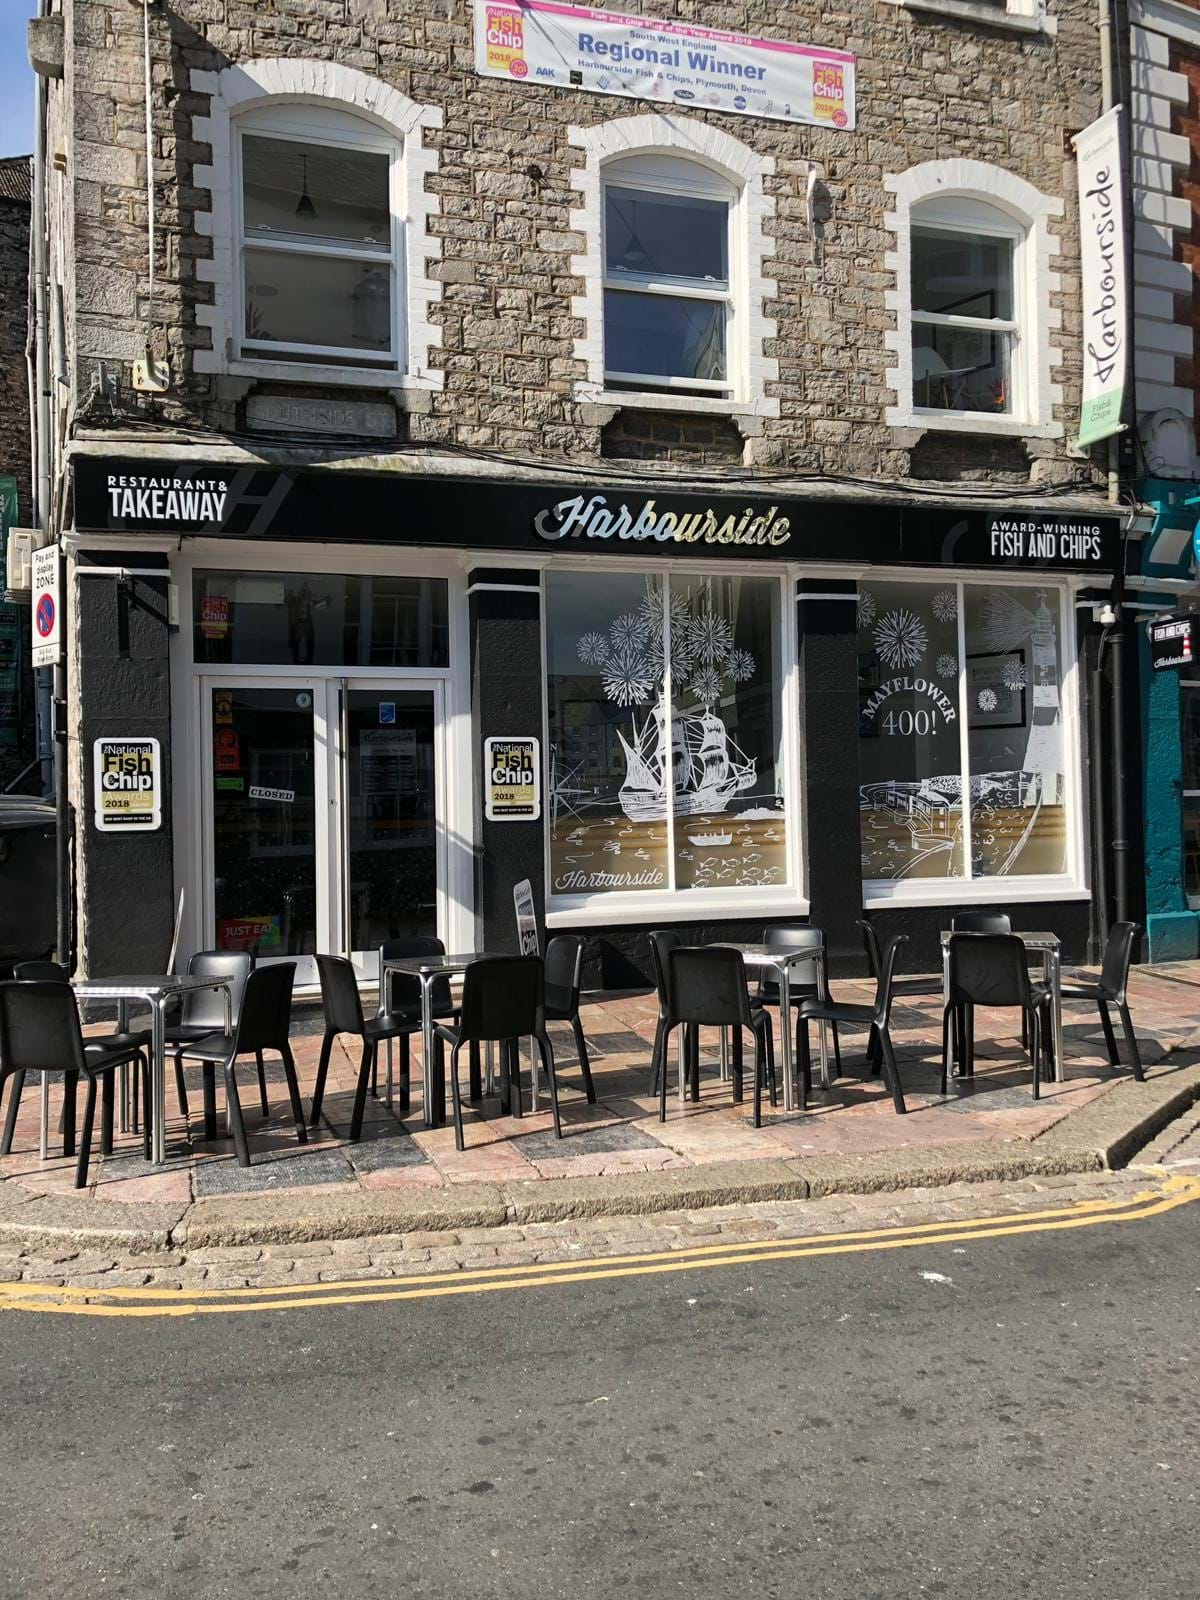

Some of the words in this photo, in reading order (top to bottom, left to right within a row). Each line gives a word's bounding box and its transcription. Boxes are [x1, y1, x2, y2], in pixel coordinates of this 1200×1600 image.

[488, 16, 522, 34] Fish
[590, 12, 607, 20] Fish
[609, 15, 623, 24] and
[626, 18, 643, 27] Chip
[665, 24, 674, 32] of
[675, 26, 688, 34] the
[691, 29, 707, 37] Year
[709, 33, 732, 42] Award
[734, 36, 752, 45] 2018
[487, 29, 522, 48] Chip
[630, 30, 655, 41] South
[657, 35, 679, 45] West
[682, 39, 717, 51] England
[488, 51, 511, 61] 2018
[578, 33, 680, 67] Regional
[687, 51, 767, 80] Winner
[536, 66, 555, 77] AAK
[578, 59, 633, 74] Harbourside
[635, 68, 654, 78] Fish
[666, 73, 693, 85] Chips,
[696, 78, 739, 92] Plymouth,
[741, 85, 767, 95] Devon
[813, 82, 843, 100] Chip
[815, 103, 833, 112] 2018
[1086, 165, 1122, 384] Harbourside
[107, 475, 228, 491] RESTAURANT&
[108, 488, 227, 522] TAKEAWAY
[534, 495, 791, 545] Harbourside
[991, 521, 1101, 535] AWARD-WINNING
[991, 531, 1023, 556] FISH
[1028, 533, 1056, 558] AND
[1060, 534, 1101, 560] CHIPS
[36, 554, 44, 564] Pay
[37, 564, 53, 576] display
[36, 573, 54, 589] ZONE
[202, 611, 227, 621] Chip
[862, 677, 956, 724] MAYFLOWER
[882, 710, 937, 736] 400!
[108, 745, 151, 754] National
[497, 743, 532, 753] National
[550, 743, 558, 751] N
[104, 753, 151, 773] Fish
[493, 751, 532, 768] Fish
[103, 771, 152, 792] Chip
[492, 767, 532, 785] Chip
[105, 791, 150, 801] Awards
[251, 789, 293, 800] CLOSED
[105, 800, 130, 808] 2018
[555, 868, 664, 890] Harbourside
[224, 926, 252, 938] JUST
[253, 924, 273, 934] EAT
